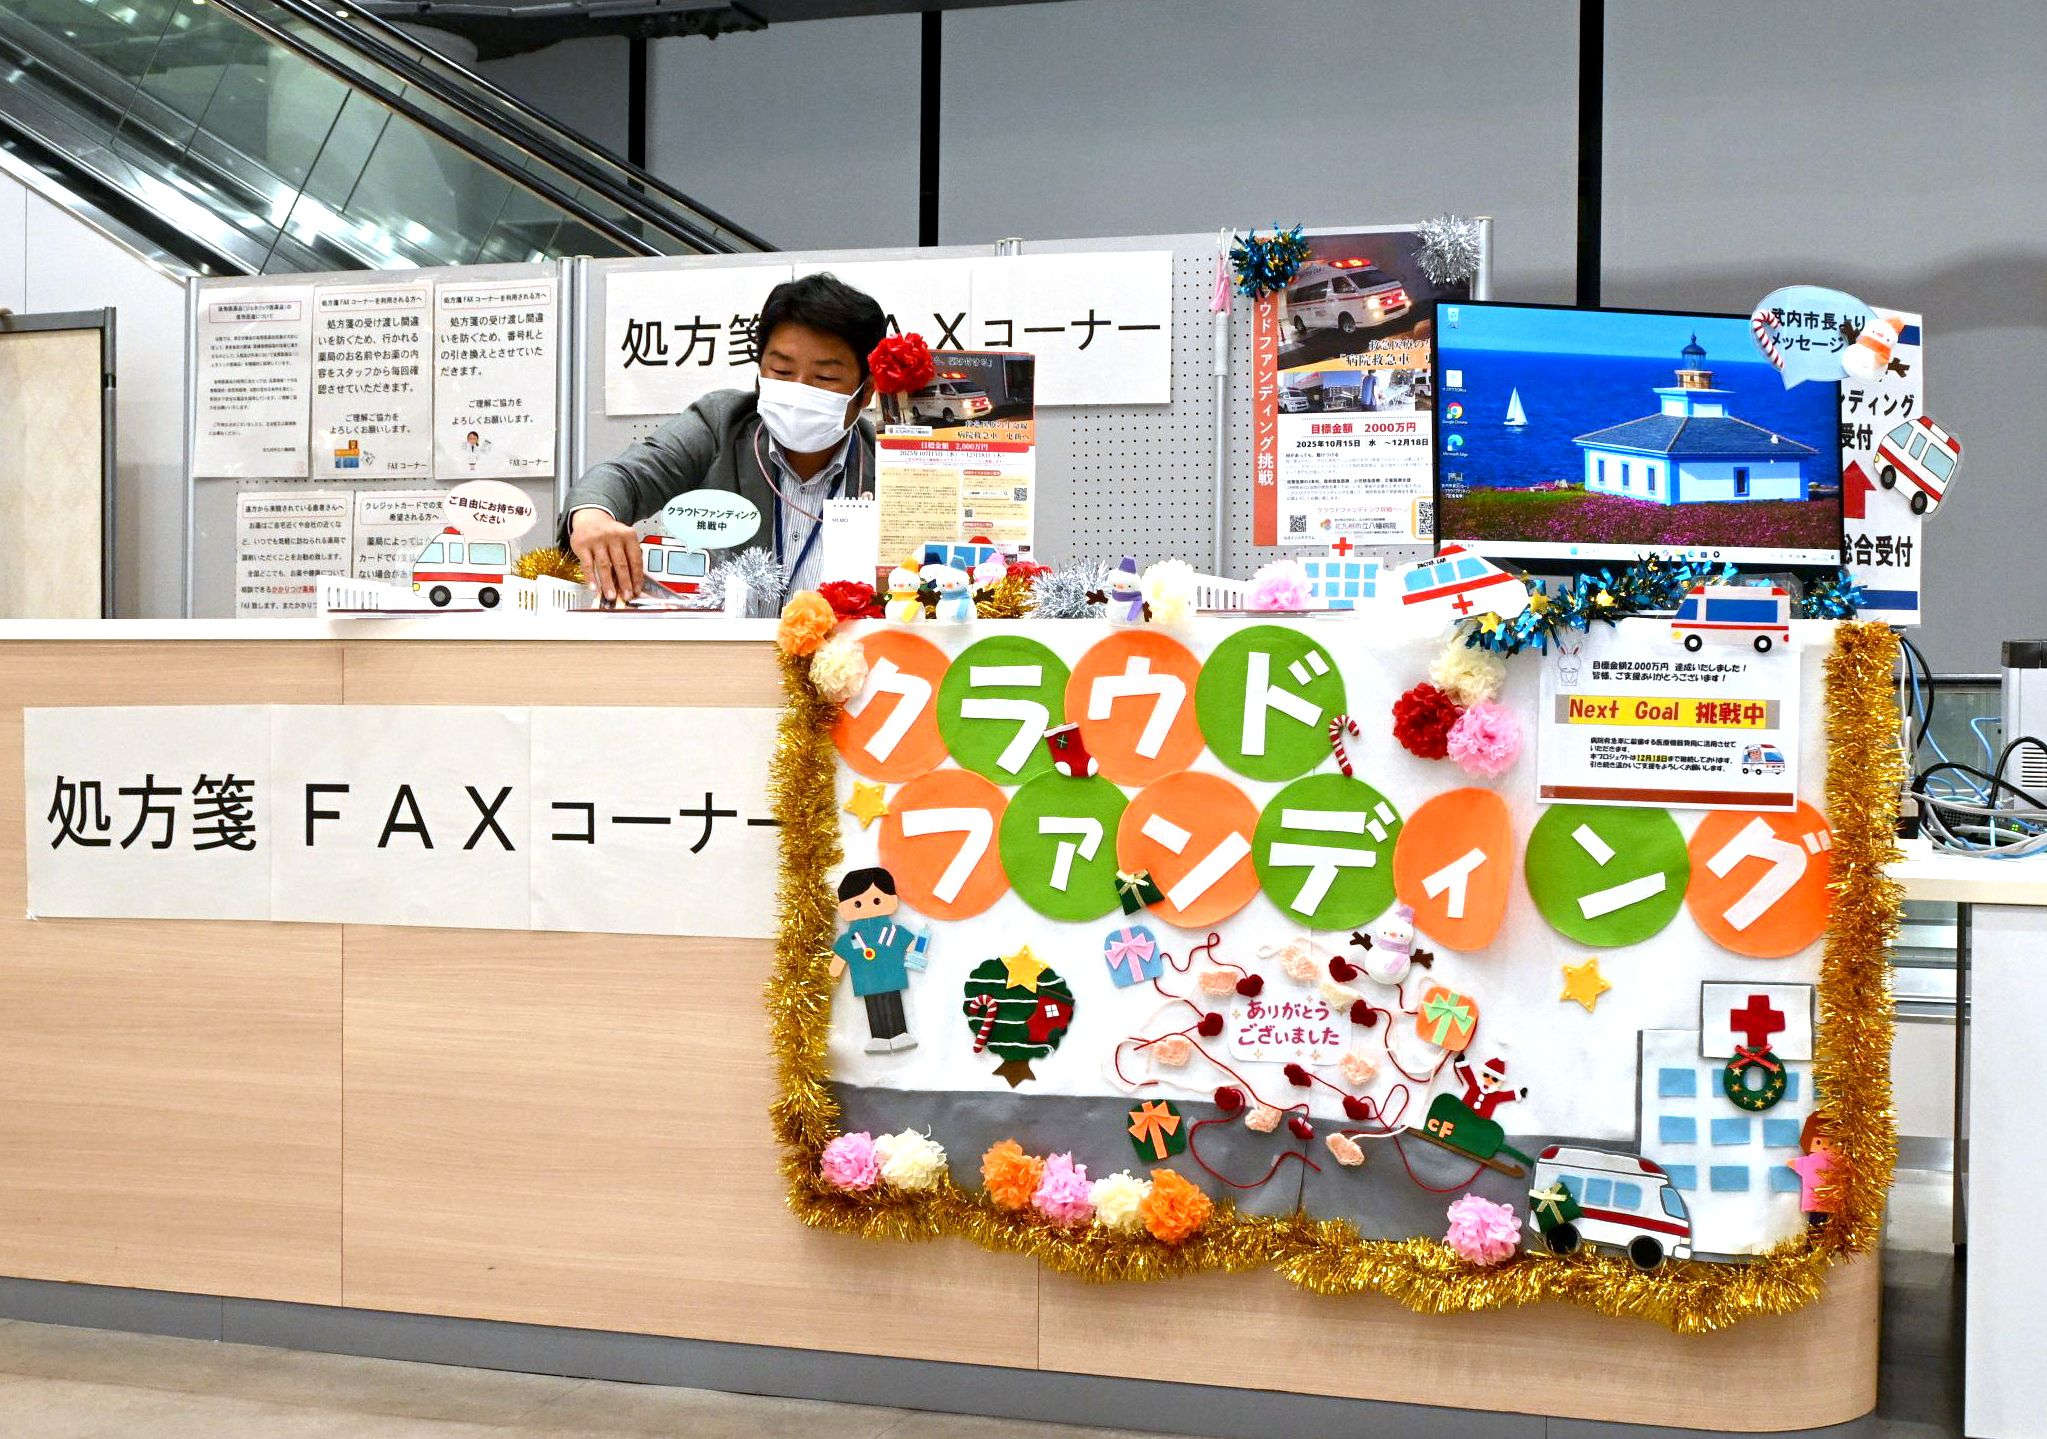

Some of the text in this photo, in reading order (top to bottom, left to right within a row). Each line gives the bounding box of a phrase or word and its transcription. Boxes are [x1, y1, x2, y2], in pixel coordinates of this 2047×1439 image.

[327, 316, 420, 329] 処方箋の受け渡し間違
[450, 312, 544, 327] 処方箋の受け渡し間違
[318, 333, 419, 346] いを防ぐため、行かれる
[440, 330, 543, 344] いを防ぐため、番号札と
[1771, 333, 1845, 353] メッセージ
[318, 349, 419, 362] 薬局のお名前やお薬の内
[440, 346, 543, 360] の引き換えとさせていた
[318, 366, 419, 379] 容をスタッフから毎回確
[440, 366, 482, 377] だきます。
[318, 382, 414, 395] 認させていただきます。
[468, 399, 523, 408] ご理解ご協力を
[1841, 389, 1915, 418] ディング
[345, 413, 400, 423] ご理解ご協力を
[451, 414, 534, 426] よろしくお願いします。
[329, 425, 411, 435] よろしくお願いします。
[1311, 422, 1417, 434] 目標金額 2000万円
[1296, 439, 1361, 448] 2025年10月15日
[449, 496, 532, 517] ご自由にお持ち帰り
[666, 506, 759, 520] クラウドファンディング
[472, 511, 506, 525] ください
[696, 521, 728, 532] 挑戦中
[843, 649, 1330, 775] クラウド
[1568, 698, 1765, 726] Next Goal 挑戦中
[901, 802, 1833, 932] ファンディング
[1247, 1000, 1330, 1021] ありがとう
[1238, 1026, 1340, 1046] ございました
[1427, 1118, 1455, 1139] CF
